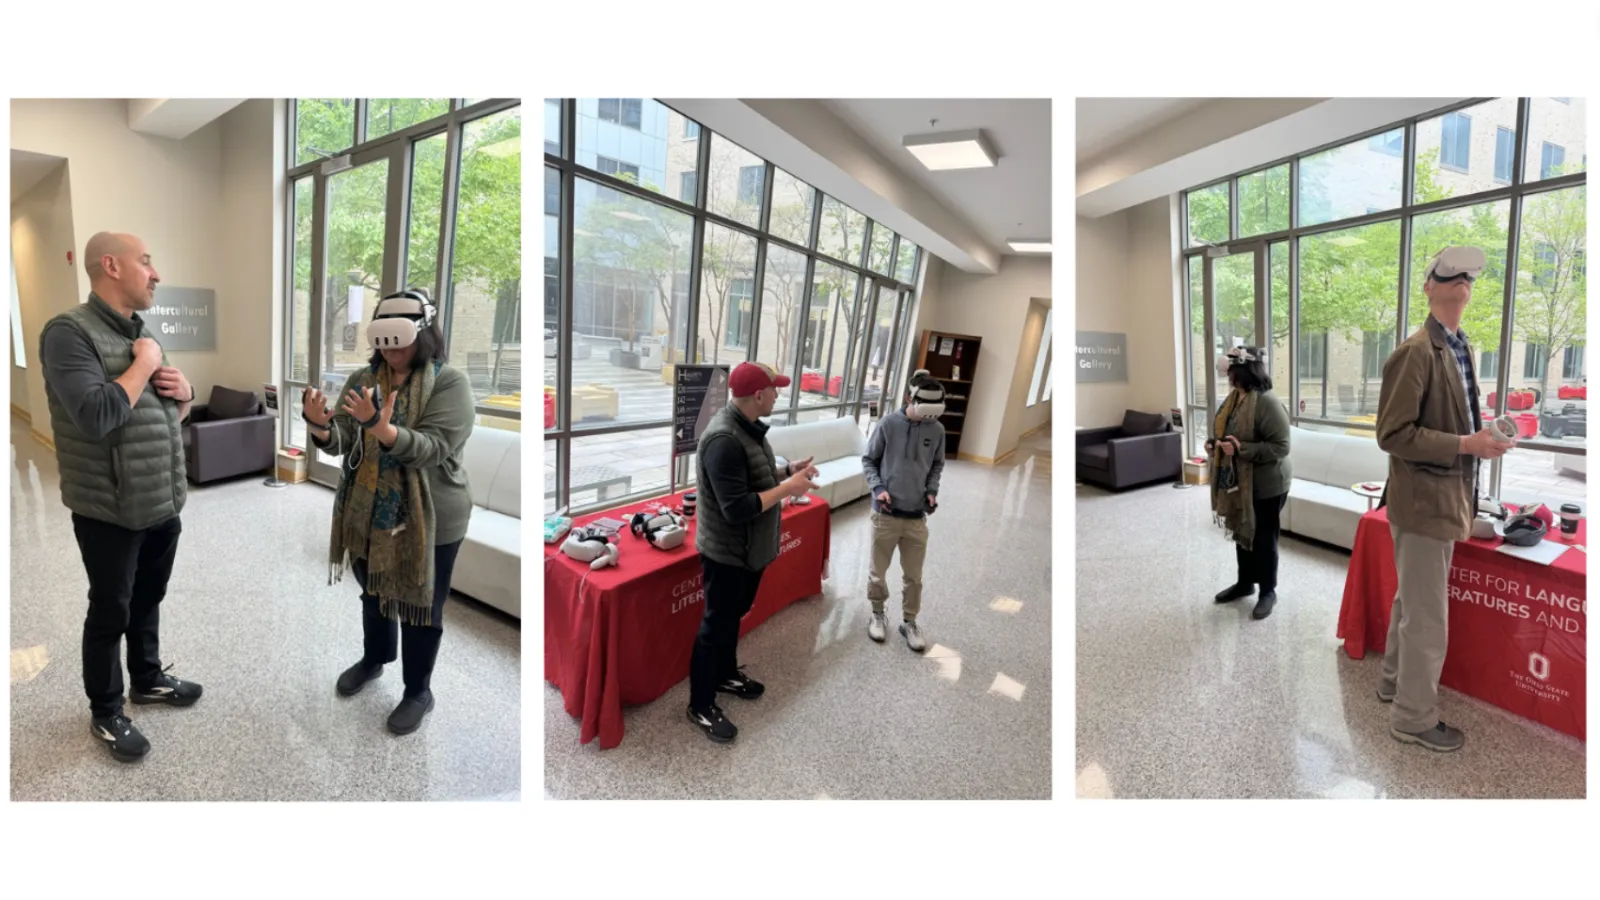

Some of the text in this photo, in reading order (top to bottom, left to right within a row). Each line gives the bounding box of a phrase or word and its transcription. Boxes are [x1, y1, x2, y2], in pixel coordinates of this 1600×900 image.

[161, 322, 199, 337] Gallery
[1079, 359, 1112, 370] Gallery
[671, 537, 802, 614] LITER TURES
[672, 573, 704, 597] CENT
[1450, 566, 1481, 585] TER
[1485, 574, 1520, 596] FOR
[1446, 584, 1580, 633] ERATURES AND
[1515, 680, 1561, 702] UNIVERSITY
